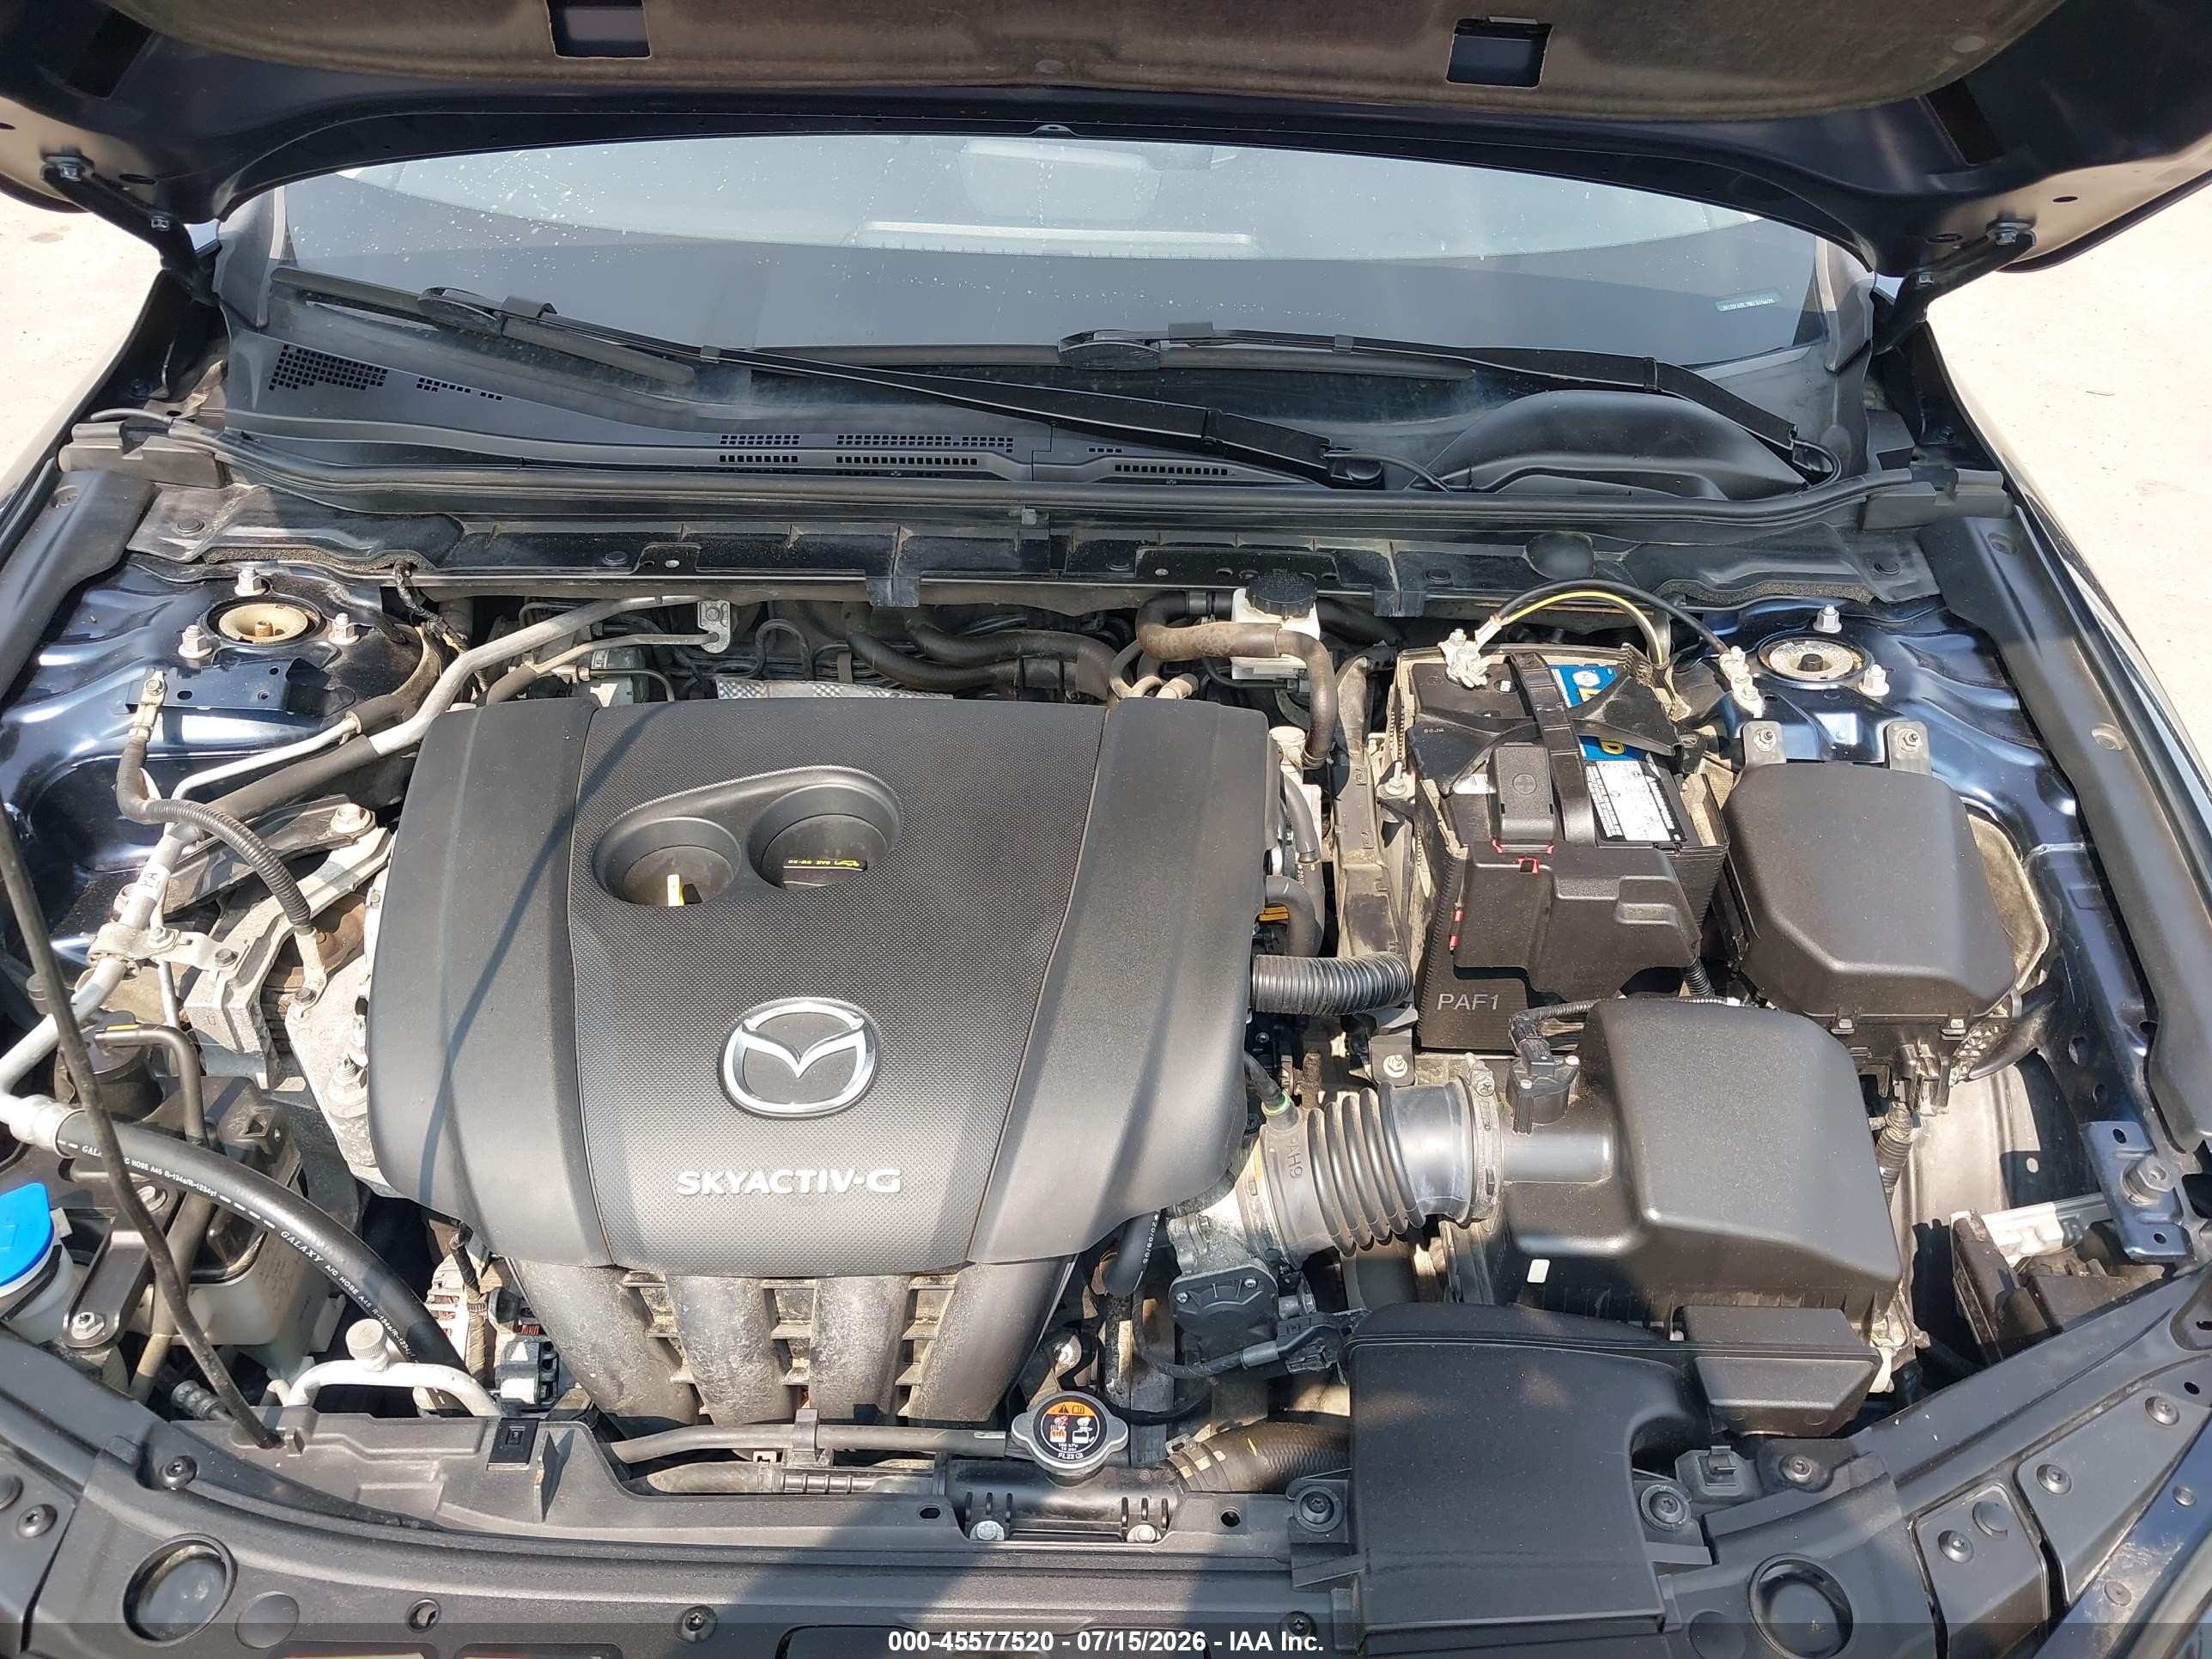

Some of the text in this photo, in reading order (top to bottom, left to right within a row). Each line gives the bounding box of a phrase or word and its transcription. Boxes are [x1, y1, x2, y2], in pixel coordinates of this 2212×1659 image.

[1437, 993, 1499, 1011] PAF1
[677, 1168, 902, 1195] SKYACTIV-G
[280, 1230, 324, 1263] GALAXY
[339, 1275, 359, 1295] HOSE
